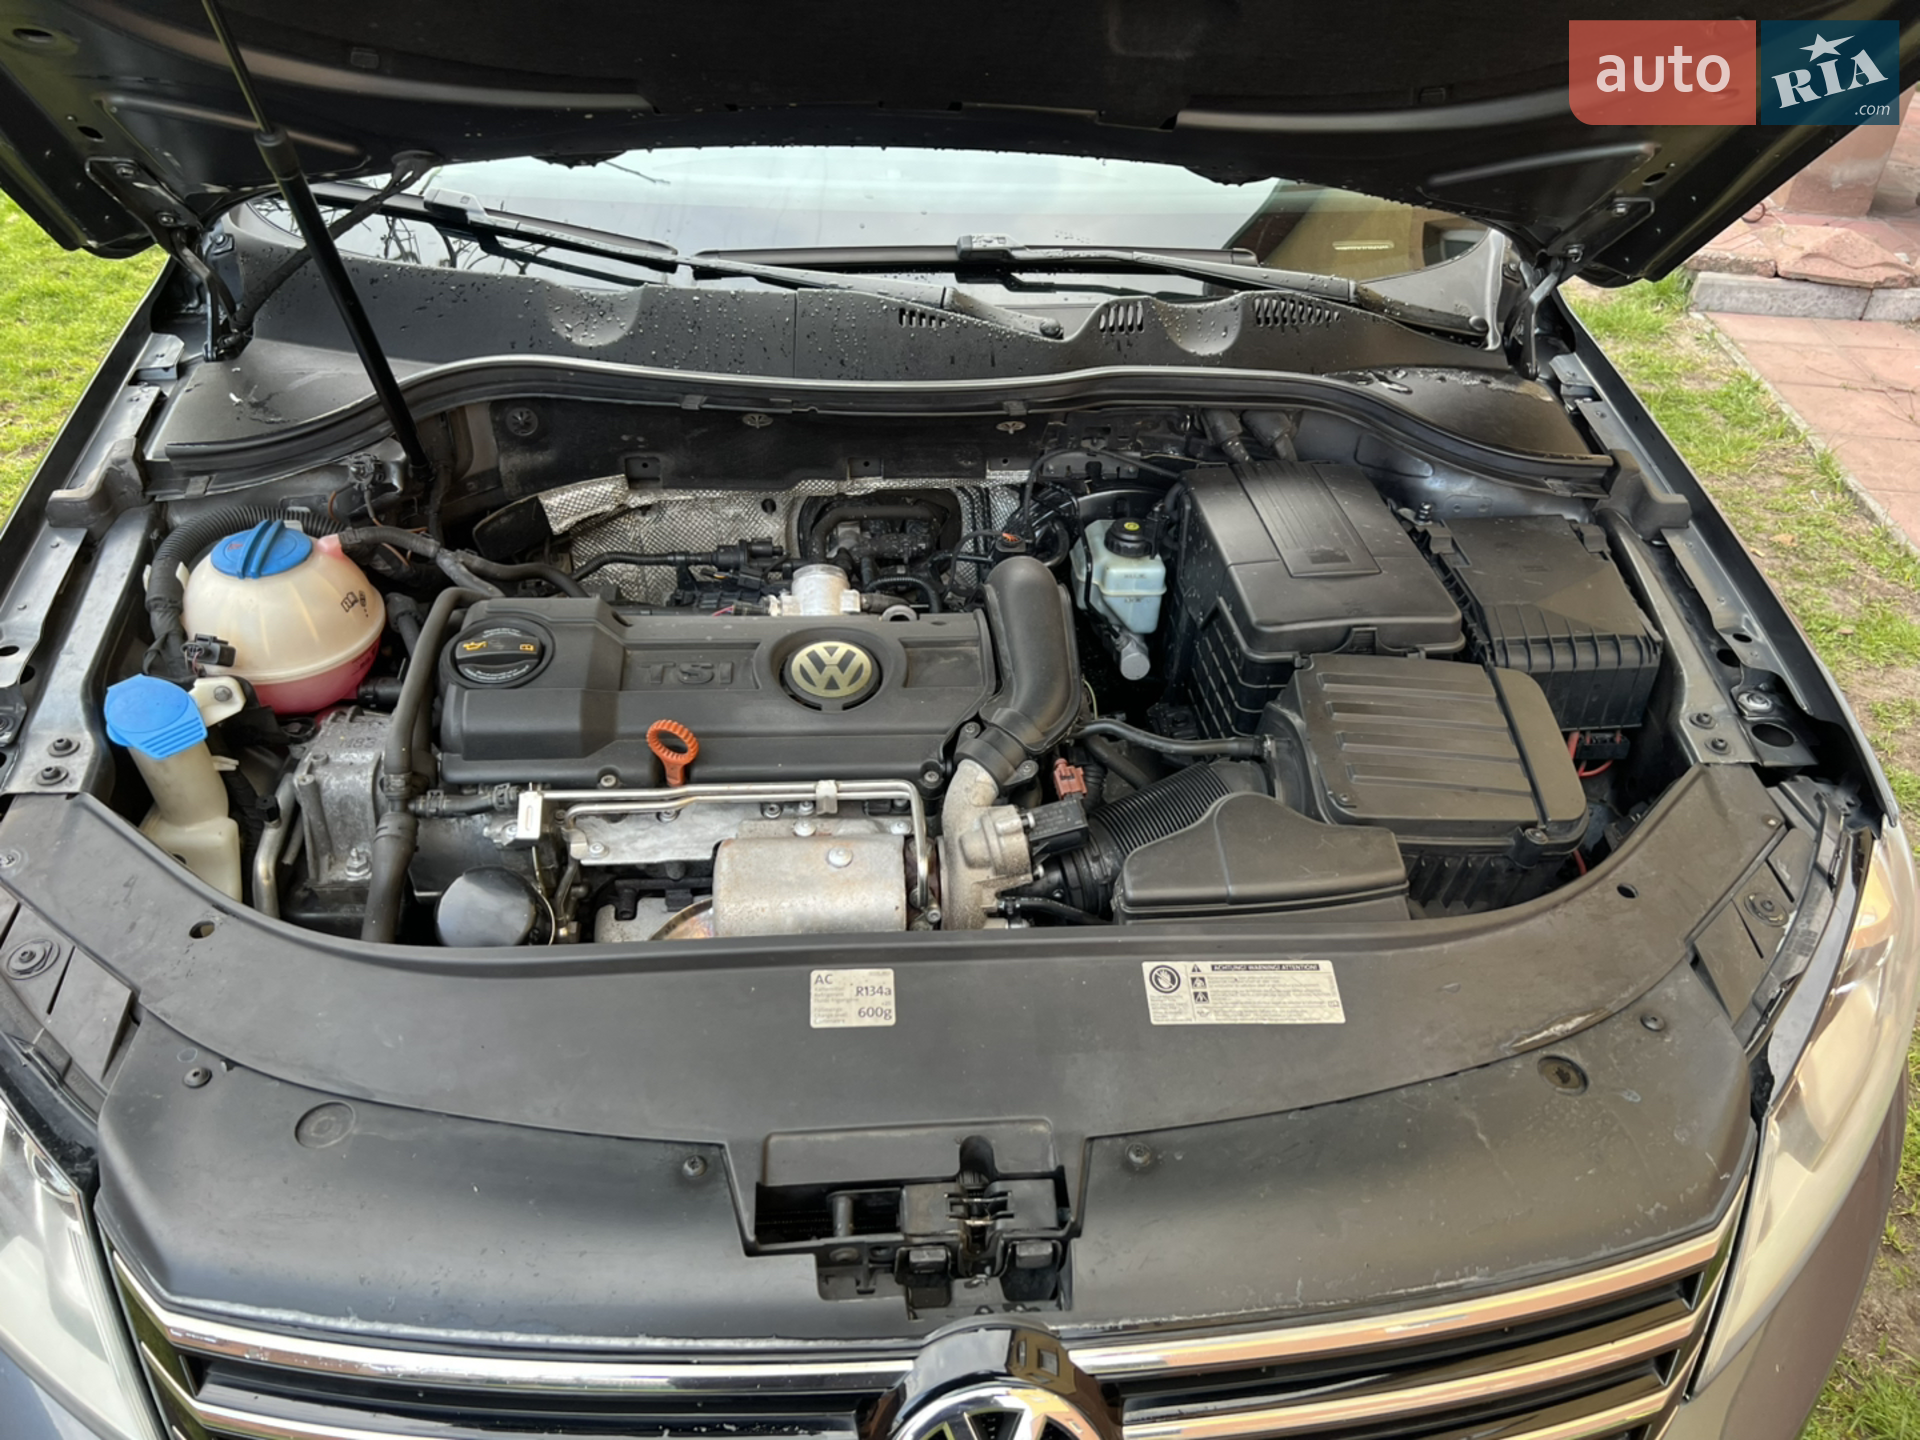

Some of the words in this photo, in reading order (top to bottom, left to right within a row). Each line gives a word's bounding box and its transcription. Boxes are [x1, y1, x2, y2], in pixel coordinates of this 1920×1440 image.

[640, 661, 735, 685] TSI
[814, 974, 834, 985] AC
[855, 986, 892, 997] R134a
[858, 1006, 893, 1021] 600g
